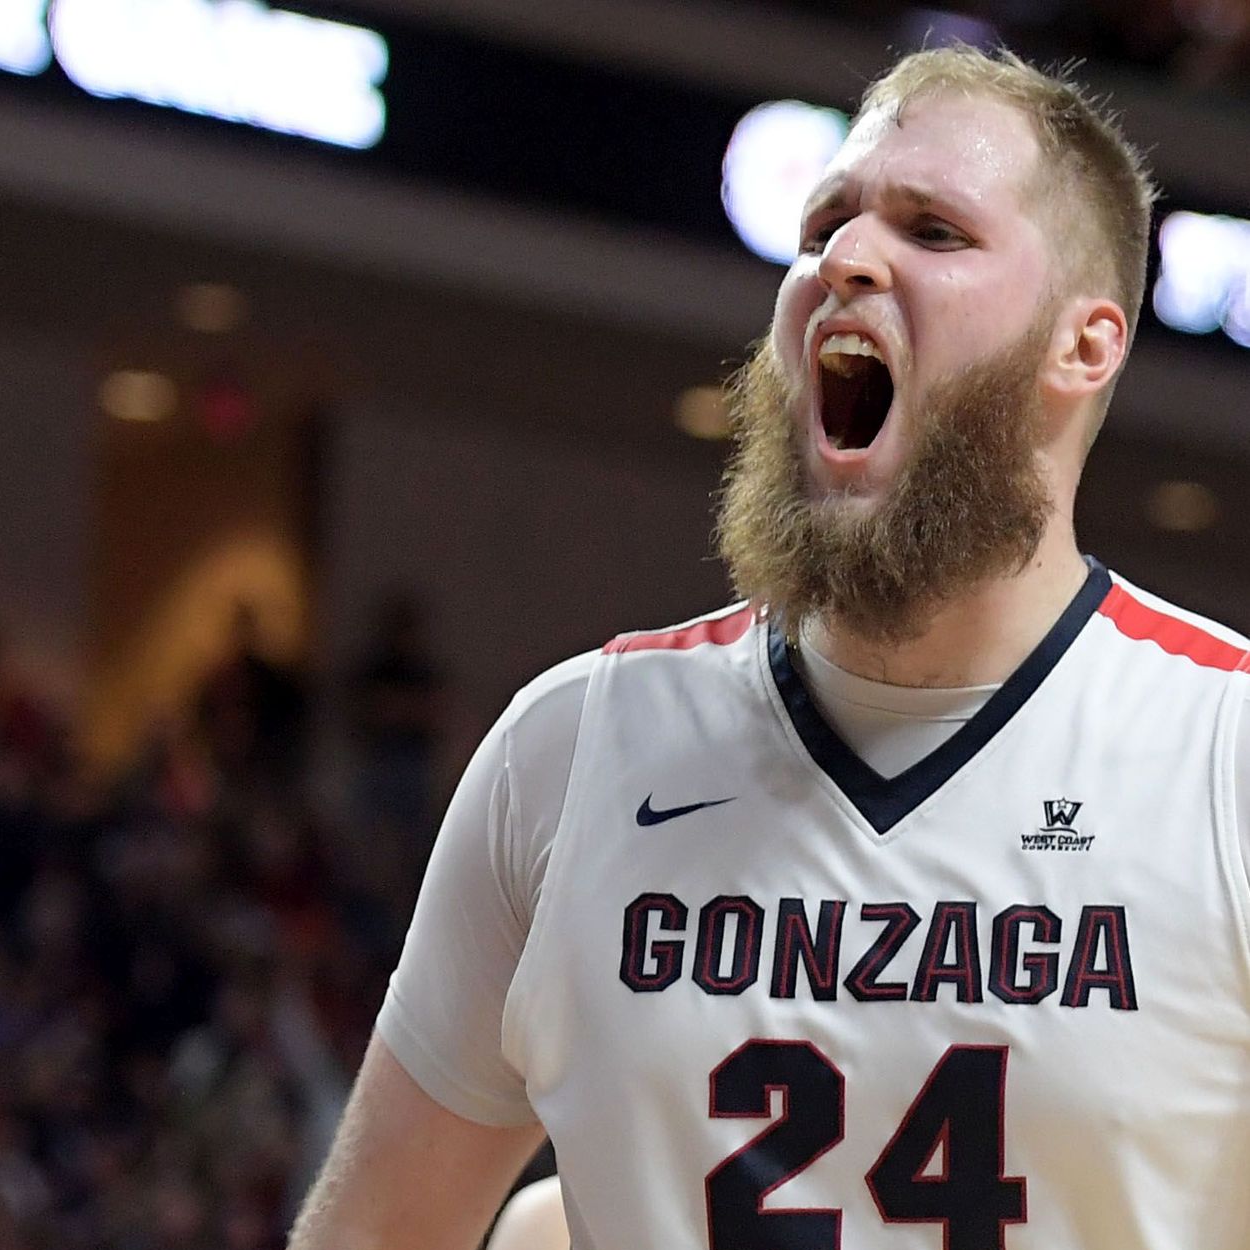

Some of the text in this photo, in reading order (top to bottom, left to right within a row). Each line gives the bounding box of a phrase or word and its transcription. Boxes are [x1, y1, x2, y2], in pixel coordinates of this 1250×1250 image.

[1021, 834, 1096, 846] WEST COAST
[620, 893, 1139, 1011] GONZAGA
